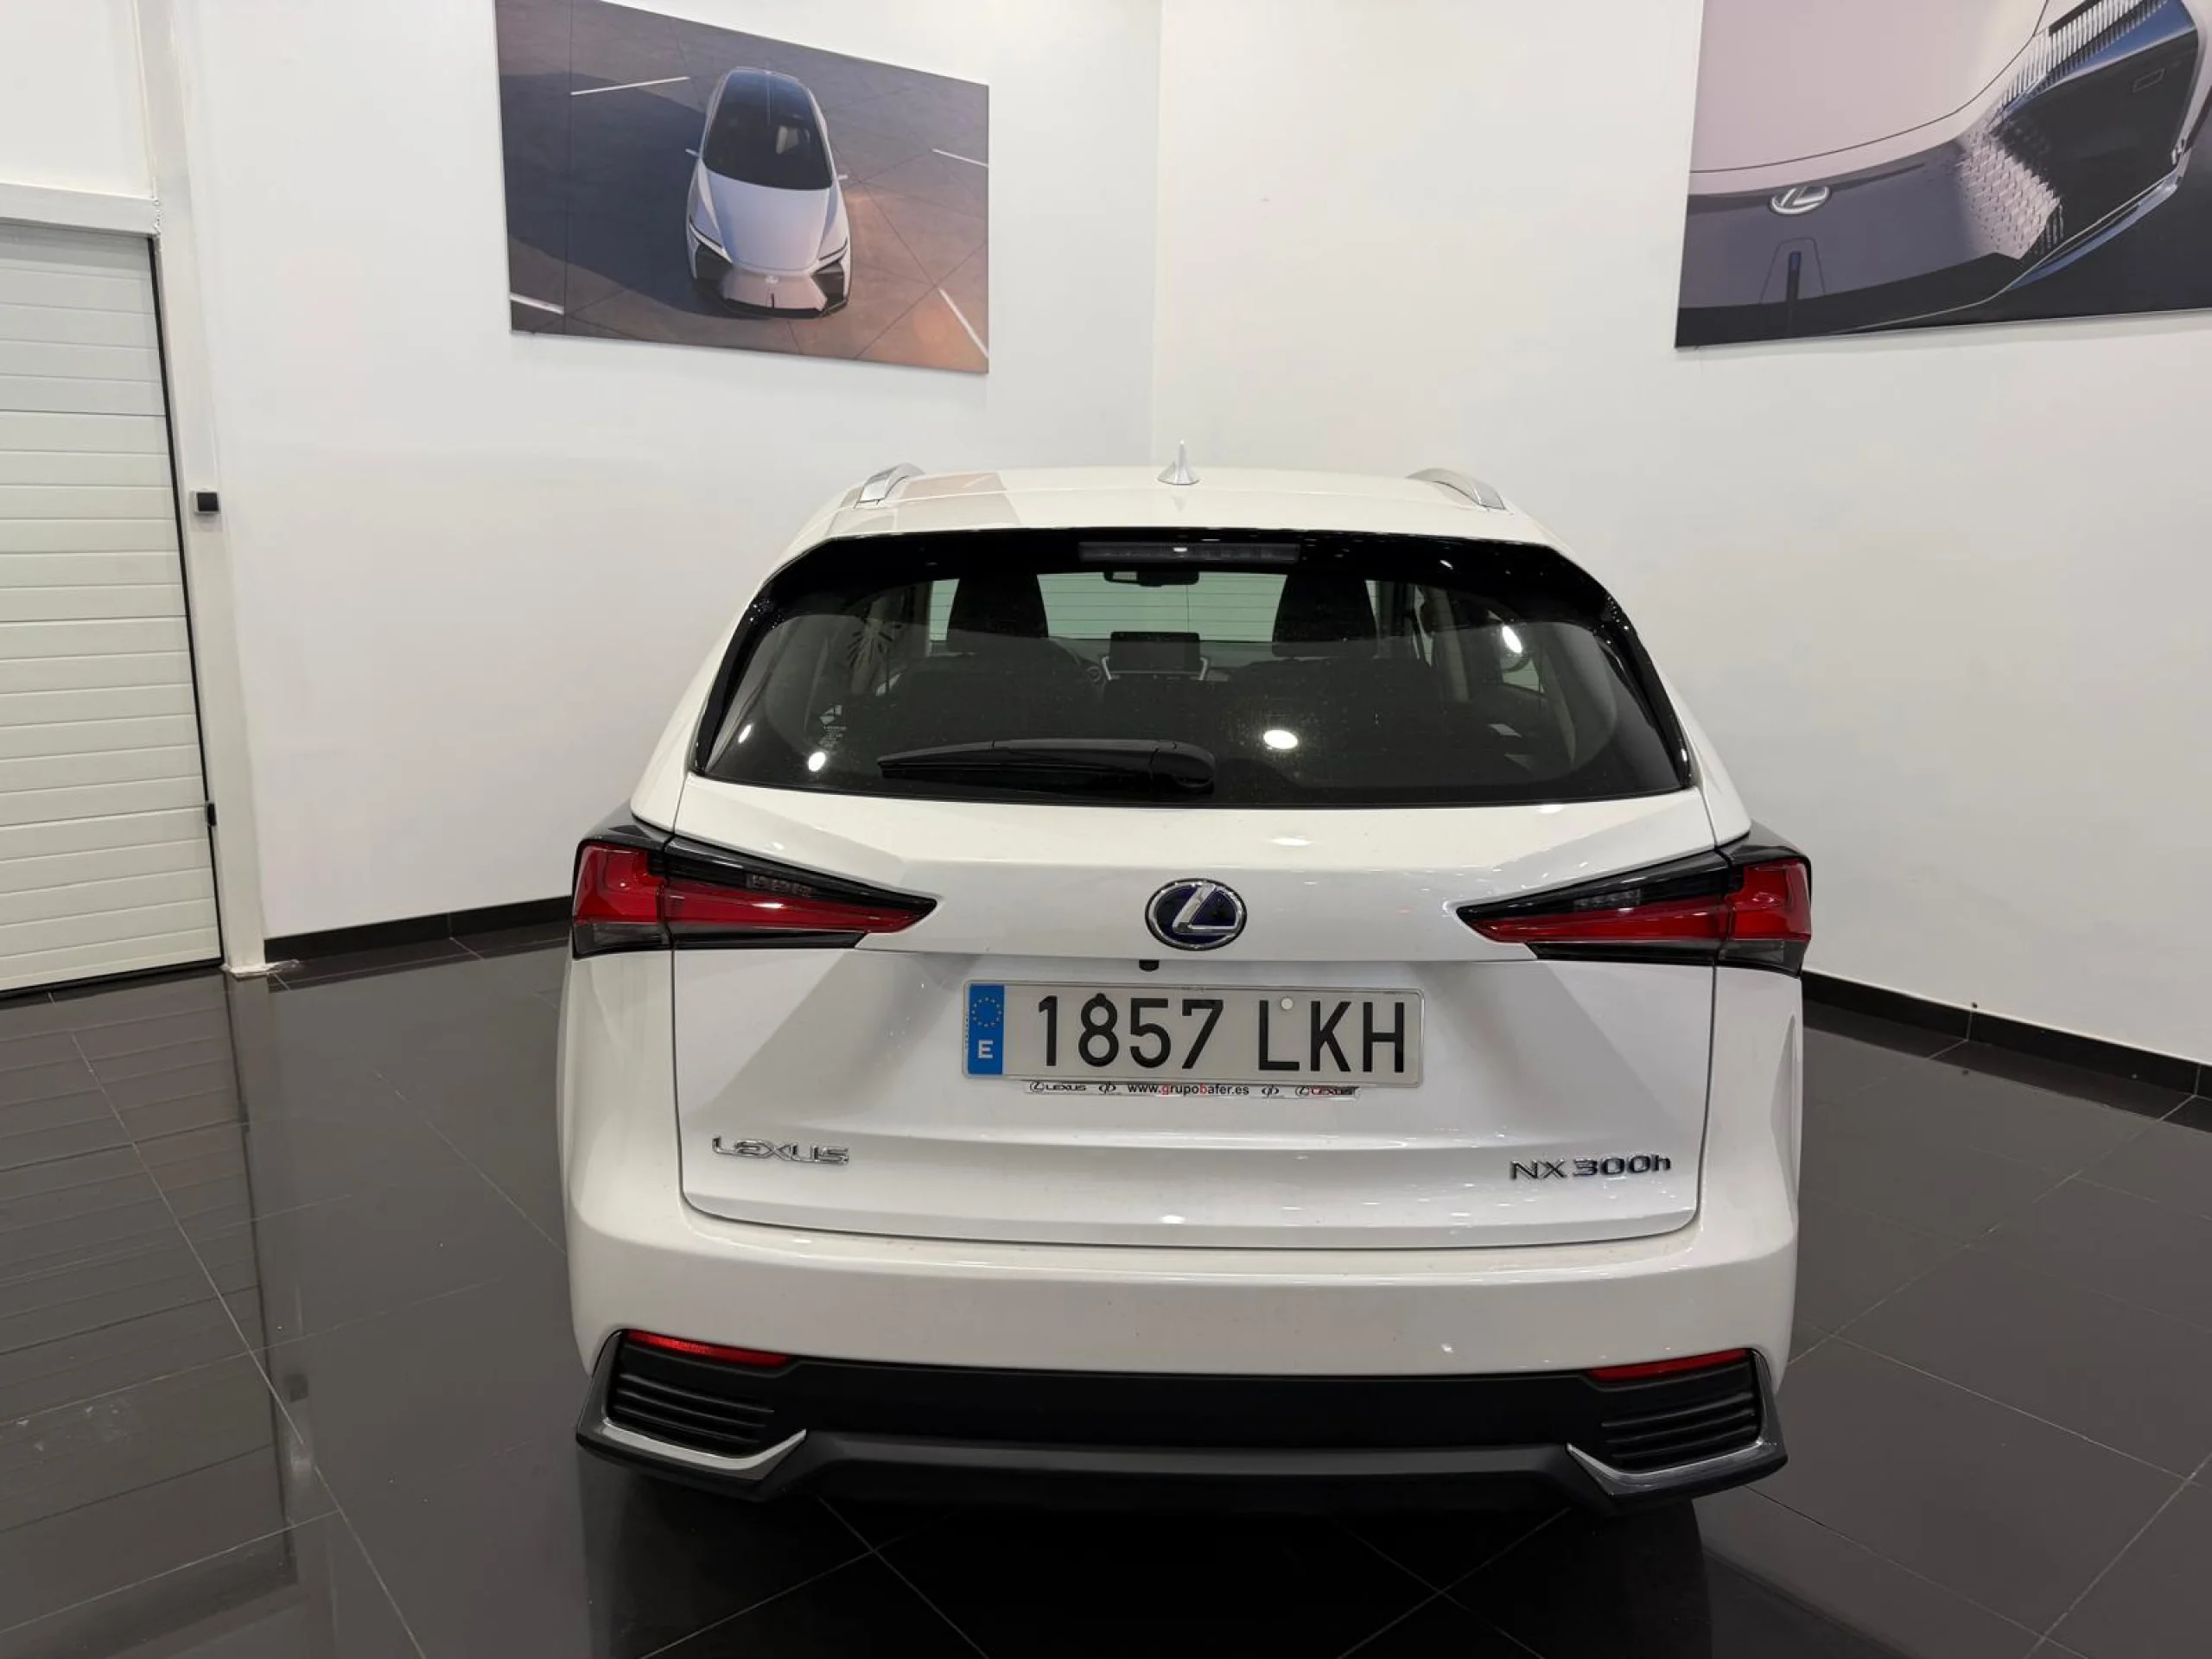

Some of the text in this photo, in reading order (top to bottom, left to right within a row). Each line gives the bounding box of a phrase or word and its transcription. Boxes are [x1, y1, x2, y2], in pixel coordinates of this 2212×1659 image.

[1038, 993, 1224, 1070] 1857
[1258, 999, 1405, 1073] LKH
[977, 1039, 994, 1059] E
[1127, 1083, 1249, 1096] www.grupobafer.es
[711, 1135, 849, 1165] LEXUS
[1510, 1154, 1671, 1180] NX 300h
